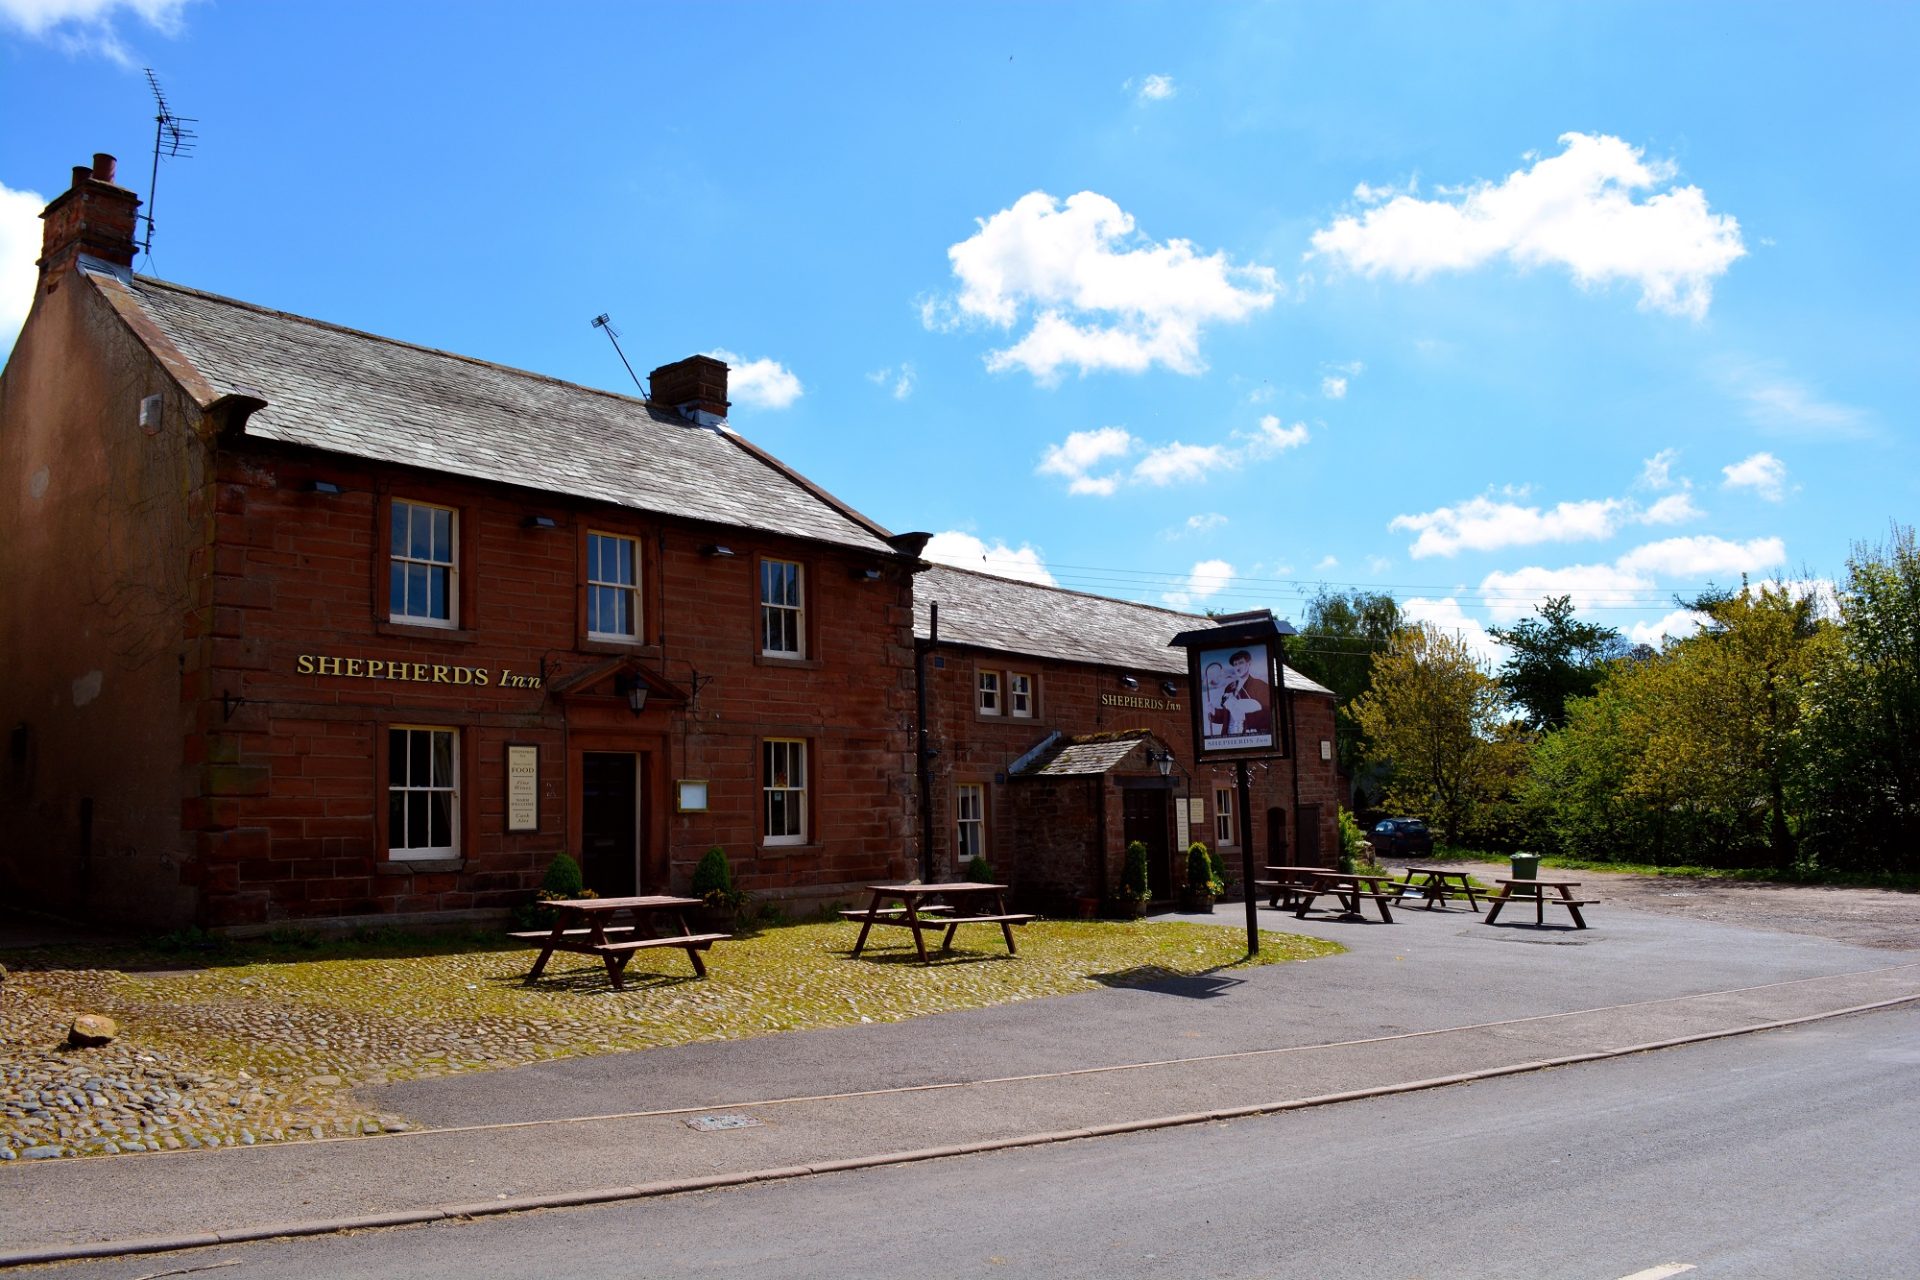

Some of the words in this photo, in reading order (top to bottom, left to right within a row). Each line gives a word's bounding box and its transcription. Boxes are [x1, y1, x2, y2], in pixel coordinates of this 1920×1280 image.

[297, 655, 489, 686] SHEPHERDS
[498, 669, 542, 689] Inn
[1101, 694, 1163, 710] SHEPHERDS
[1165, 700, 1181, 711] Inn
[1207, 738, 1254, 747] SHEPHERDS
